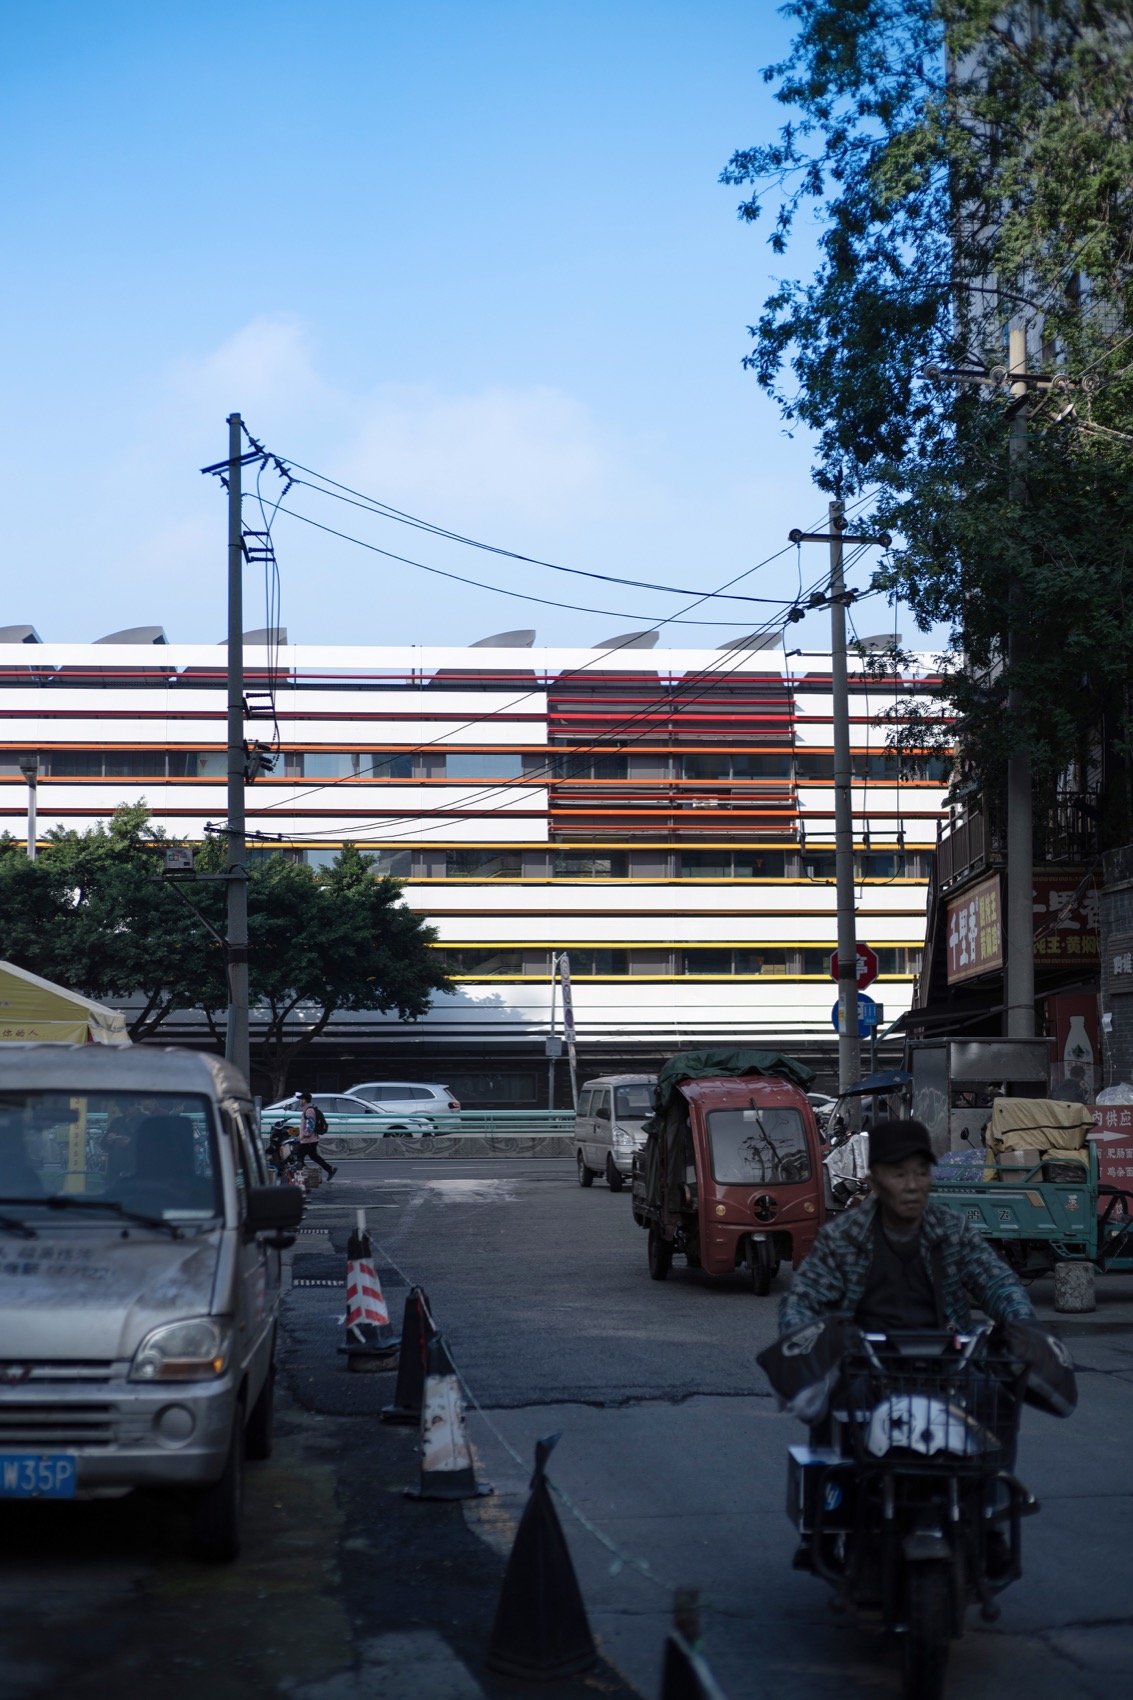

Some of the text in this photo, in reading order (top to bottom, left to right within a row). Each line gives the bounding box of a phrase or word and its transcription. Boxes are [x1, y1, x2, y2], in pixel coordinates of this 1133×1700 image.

[949, 901, 978, 971] 千里香
[1091, 1110, 1132, 1127] 内供应
